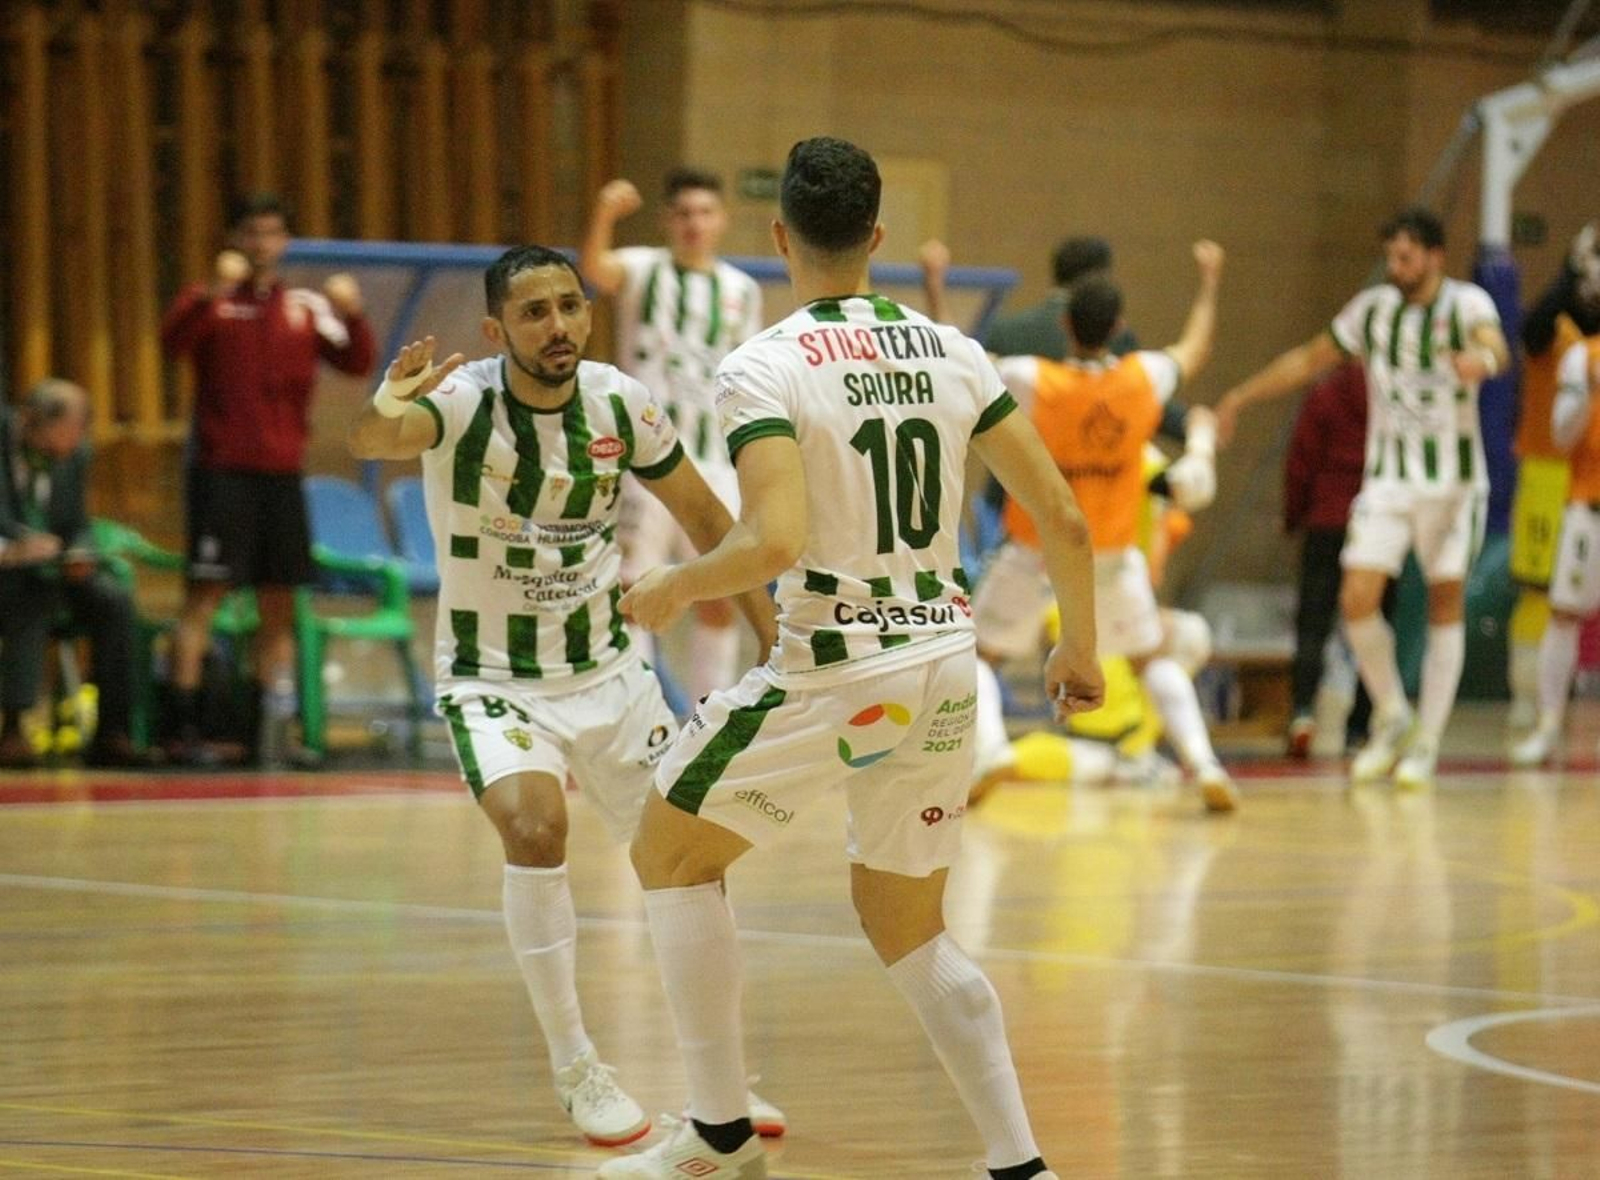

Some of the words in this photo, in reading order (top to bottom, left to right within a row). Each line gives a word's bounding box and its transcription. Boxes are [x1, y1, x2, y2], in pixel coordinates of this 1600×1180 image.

[798, 325, 946, 367] STILOTEXTIL
[843, 371, 935, 406] SAURA
[849, 417, 942, 555] 10
[493, 564, 579, 588] Mzquita
[523, 577, 598, 602] Catedal
[922, 737, 962, 752] 2021
[734, 789, 795, 824] efficol
